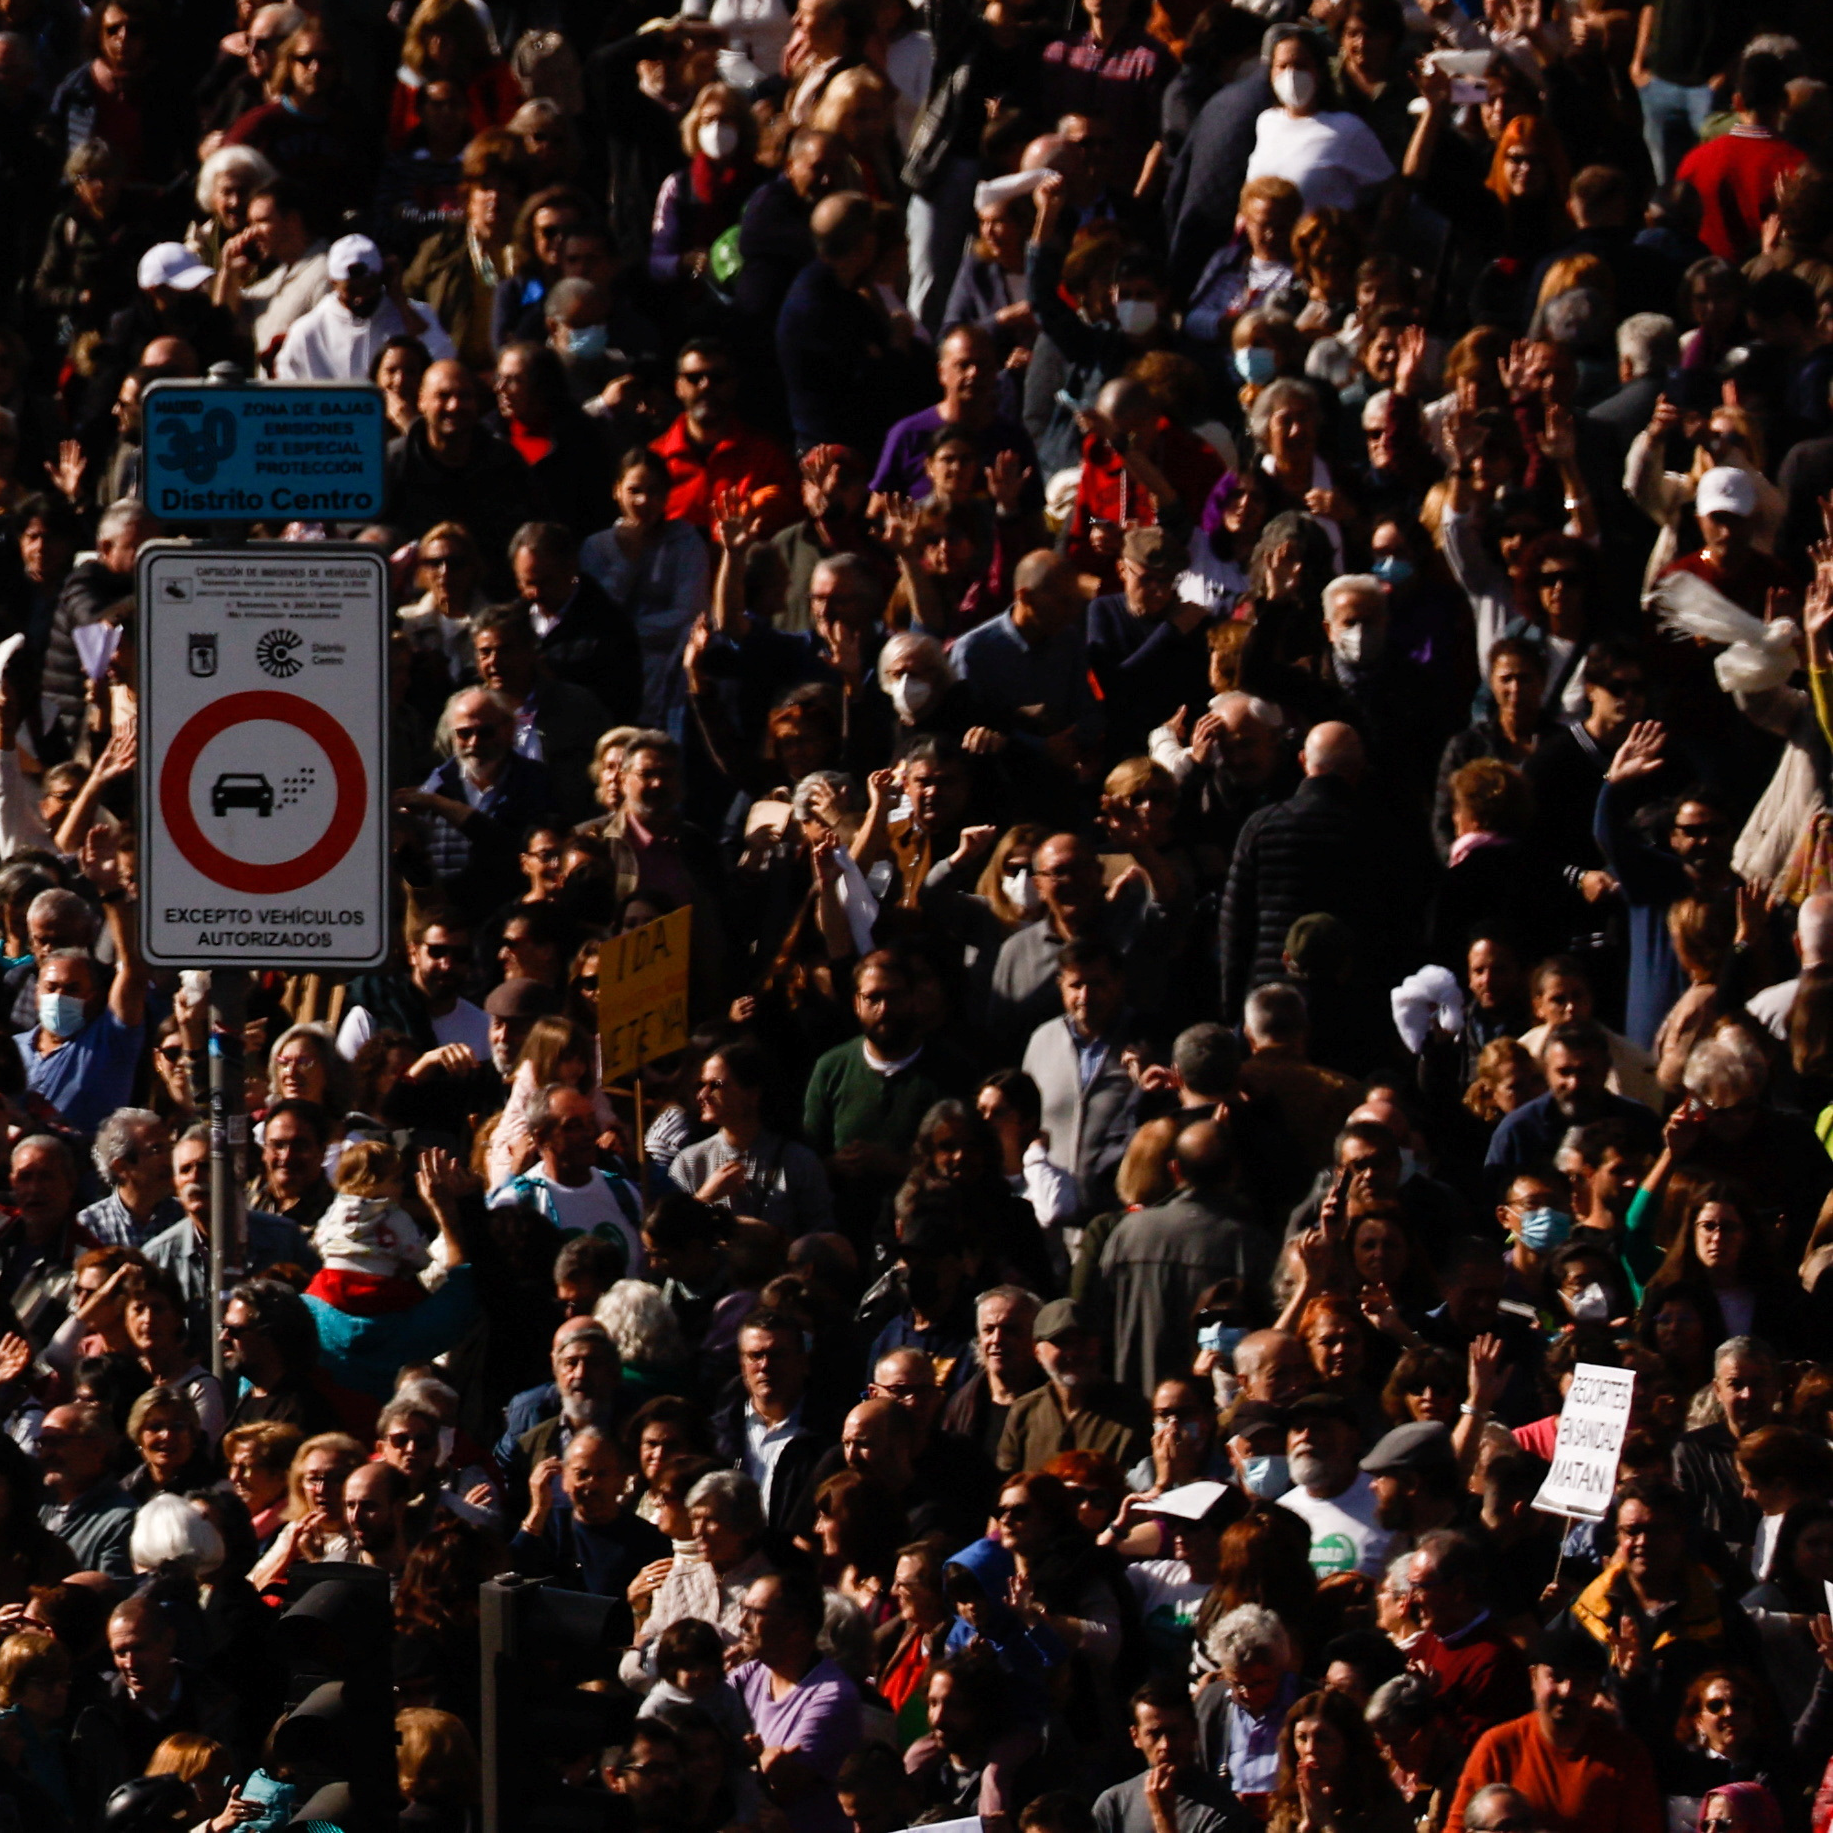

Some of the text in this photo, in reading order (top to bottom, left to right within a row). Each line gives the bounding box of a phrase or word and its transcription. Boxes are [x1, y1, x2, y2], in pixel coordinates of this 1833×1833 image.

[243, 402, 375, 415] ZONA DE BAJAS
[264, 422, 354, 436] EMISIONES
[255, 442, 362, 456] DE ESPECIAL
[256, 460, 363, 474] PROTECCIÓN
[162, 488, 373, 511] Distrito Centro
[165, 906, 364, 926] EXCEPTO VEHÍCULOS
[198, 930, 332, 949] AUTORIZADOS
[617, 919, 672, 982] IDA
